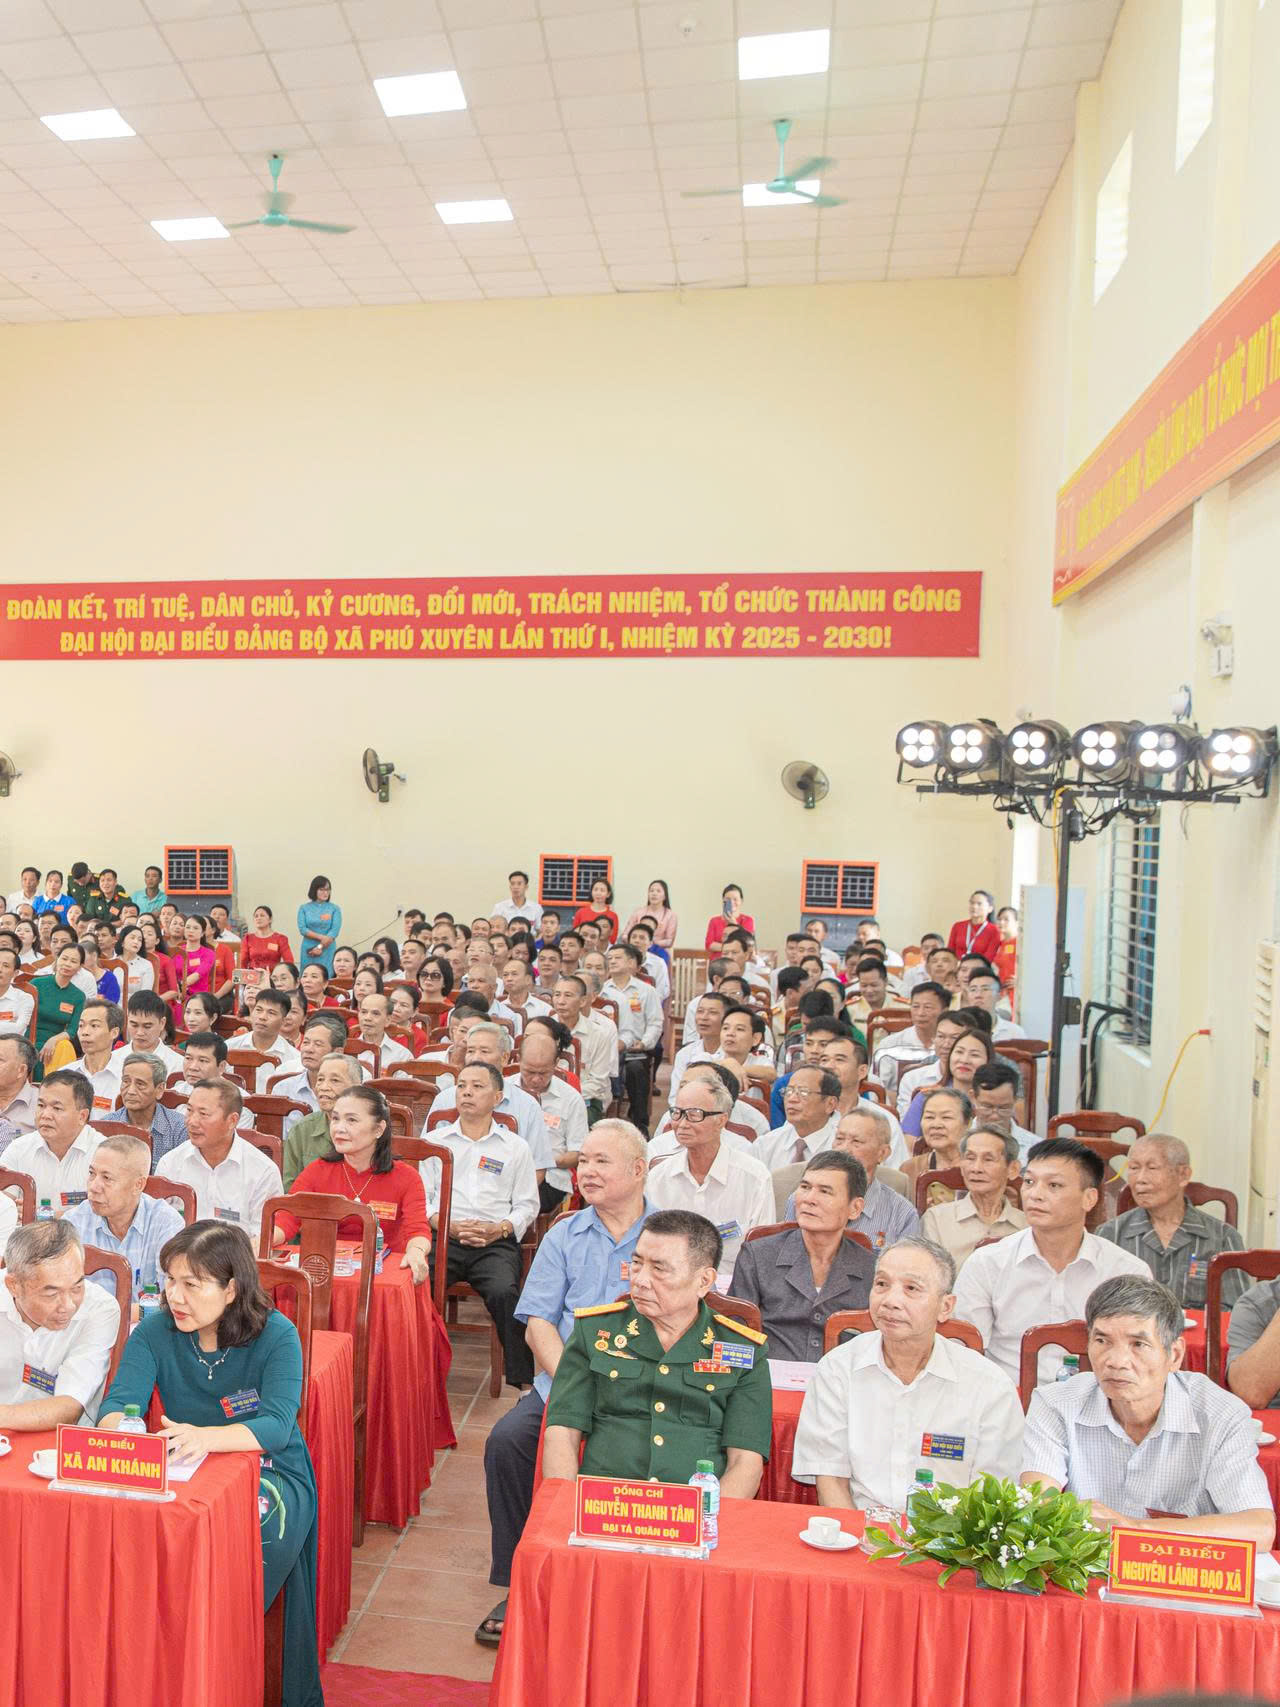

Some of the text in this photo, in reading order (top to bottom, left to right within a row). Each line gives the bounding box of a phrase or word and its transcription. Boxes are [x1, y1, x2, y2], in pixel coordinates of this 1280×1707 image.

[7, 582, 962, 625] ĐOÀN KẾT, TRÍ TUỆ, DÂN CHỦ, KỶ CƯƠNG, ĐỔI MỚI, TRÁCH NHIỆM, TỔ CHỨC THÀNH CÔNG
[60, 631, 95, 657] ĐẠI
[100, 627, 135, 656] HỘI
[140, 631, 173, 656] ĐẠI
[181, 621, 229, 652] BIỂU
[234, 623, 293, 651] ĐẢNG
[299, 625, 329, 655] BỘ
[334, 625, 364, 651] XÃ
[370, 624, 414, 650] PHÚ
[420, 623, 493, 650] XUYÊN
[500, 620, 544, 649] LẦN
[550, 622, 596, 649] THỨ
[600, 627, 614, 652] I,
[622, 622, 698, 653] NHIỆM
[705, 621, 736, 649] KỲ
[742, 626, 800, 649] 2025
[823, 625, 893, 649] 2030!
[87, 1438, 135, 1450] ĐẠI BIỂU
[63, 1452, 160, 1478] XÃ AN KHÁNH
[646, 1488, 663, 1498] CHÍ
[584, 1497, 694, 1523] NGUYỄN THANH TÂM
[602, 1522, 619, 1533] ĐẠI
[634, 1525, 661, 1537] QUÂN
[663, 1527, 680, 1539] ĐỘI
[1139, 1543, 1174, 1557] ĐẠI
[1122, 1560, 1242, 1593] NGUYÊN LÃNH ĐẠO XÃ
